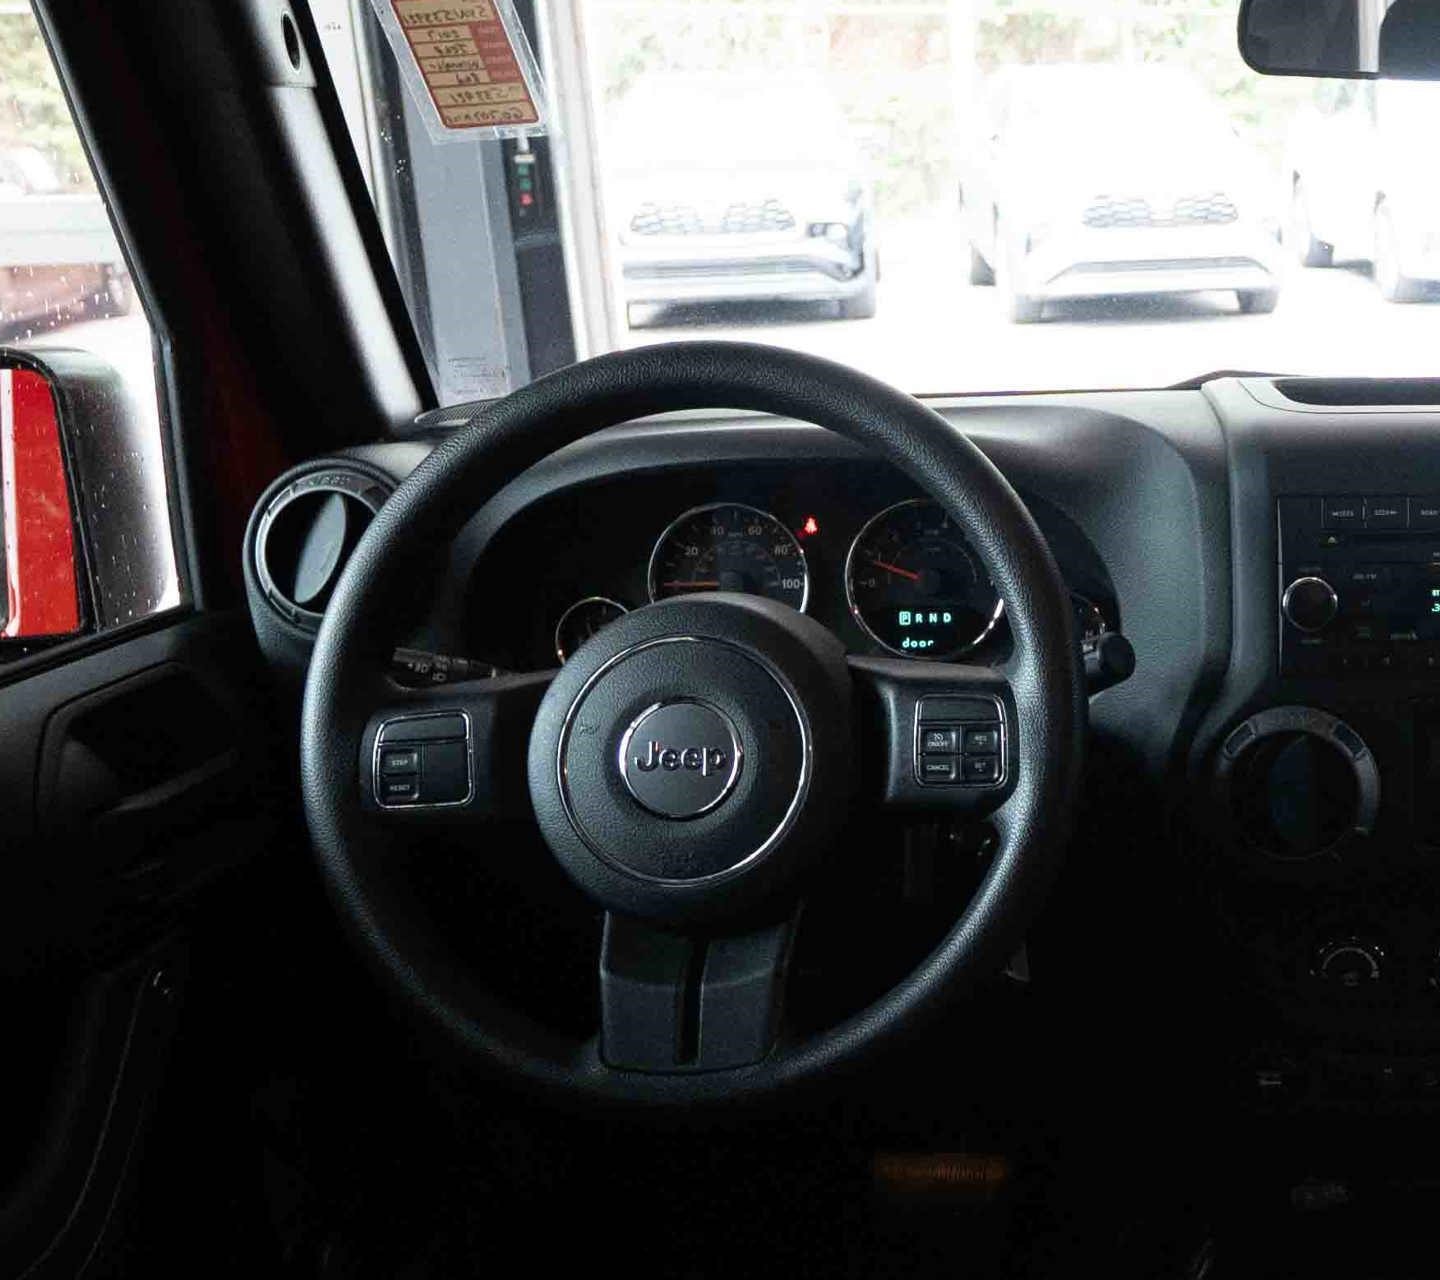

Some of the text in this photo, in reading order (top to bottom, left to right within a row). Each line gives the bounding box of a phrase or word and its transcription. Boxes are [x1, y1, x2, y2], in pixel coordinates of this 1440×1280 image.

[781, 578, 800, 590] 100
[915, 613, 923, 623] R
[929, 613, 939, 623] N
[943, 613, 952, 623] D
[901, 637, 935, 649] door
[635, 740, 727, 778] Jeep
